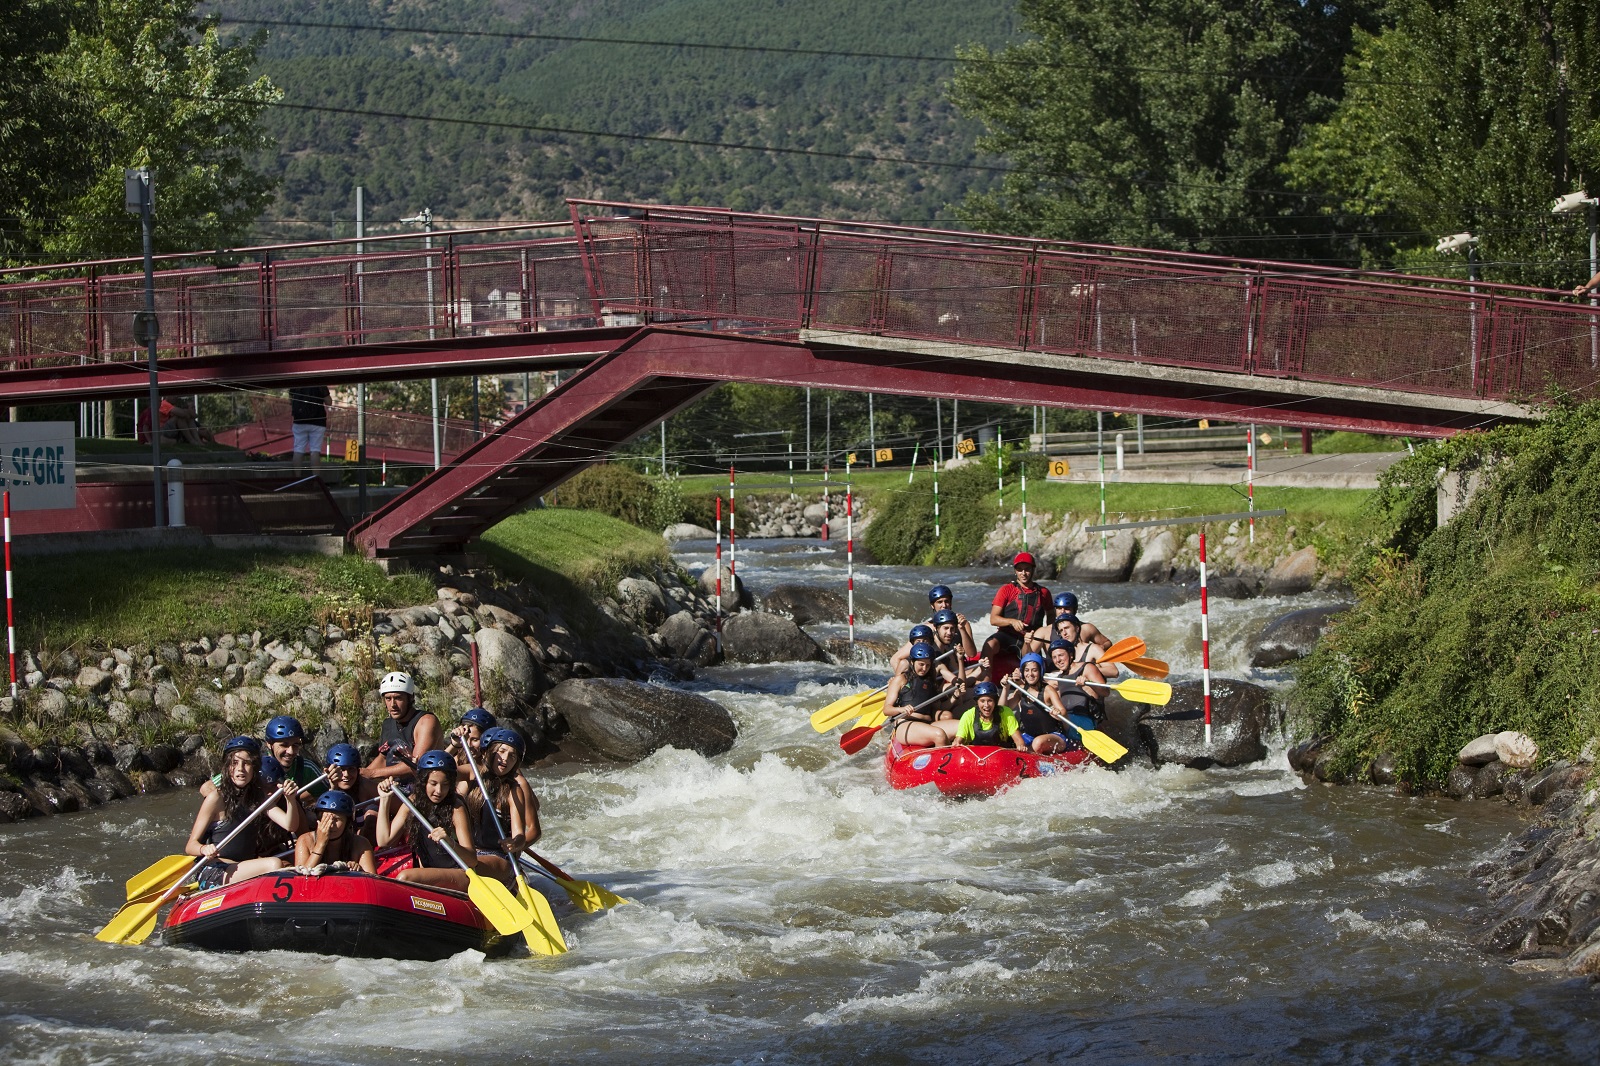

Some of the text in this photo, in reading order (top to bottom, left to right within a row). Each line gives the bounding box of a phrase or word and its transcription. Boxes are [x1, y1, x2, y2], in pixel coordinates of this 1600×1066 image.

[351, 440, 358, 450] 8
[957, 440, 973, 454] 86
[348, 451, 358, 460] 11
[880, 450, 887, 460] 6
[12, 445, 65, 486] SEGRE
[1055, 461, 1064, 475] 6
[938, 753, 952, 774] 2
[1015, 756, 1030, 779] 2
[272, 876, 294, 903] 5
